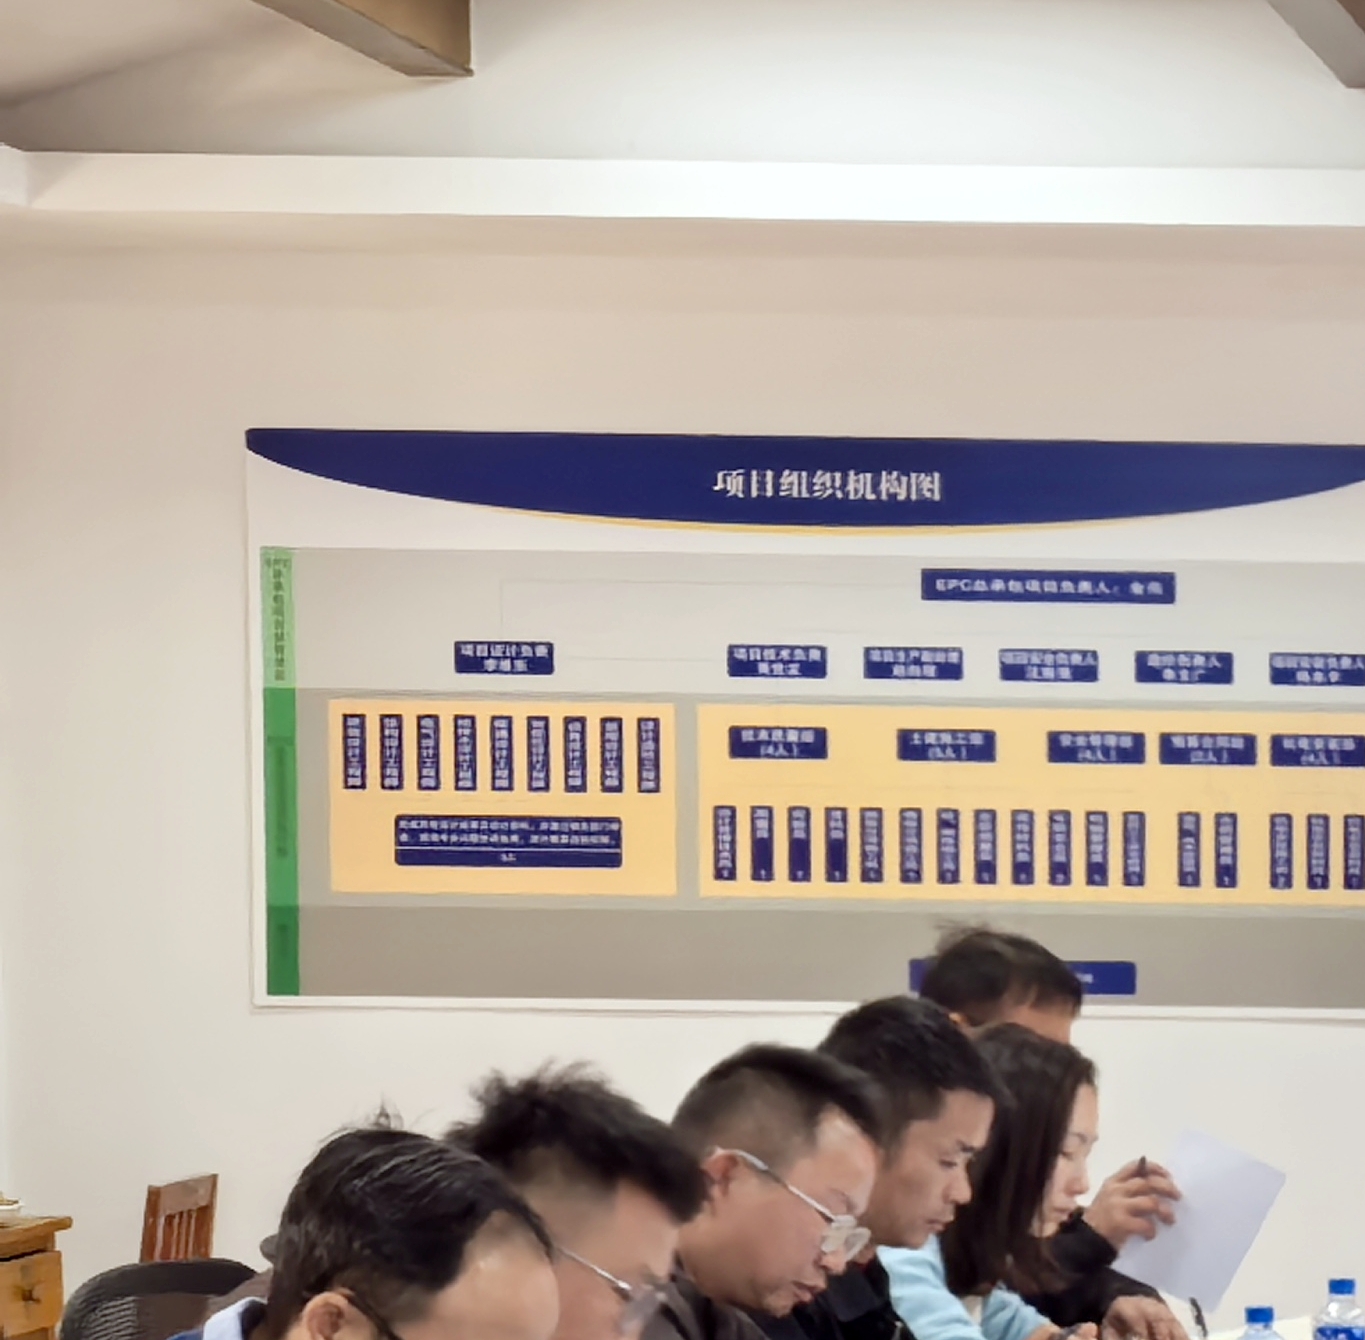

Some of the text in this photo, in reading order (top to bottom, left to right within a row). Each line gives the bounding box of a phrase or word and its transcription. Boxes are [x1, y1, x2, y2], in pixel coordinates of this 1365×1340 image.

[713, 469, 941, 502] 项目组织机构图
